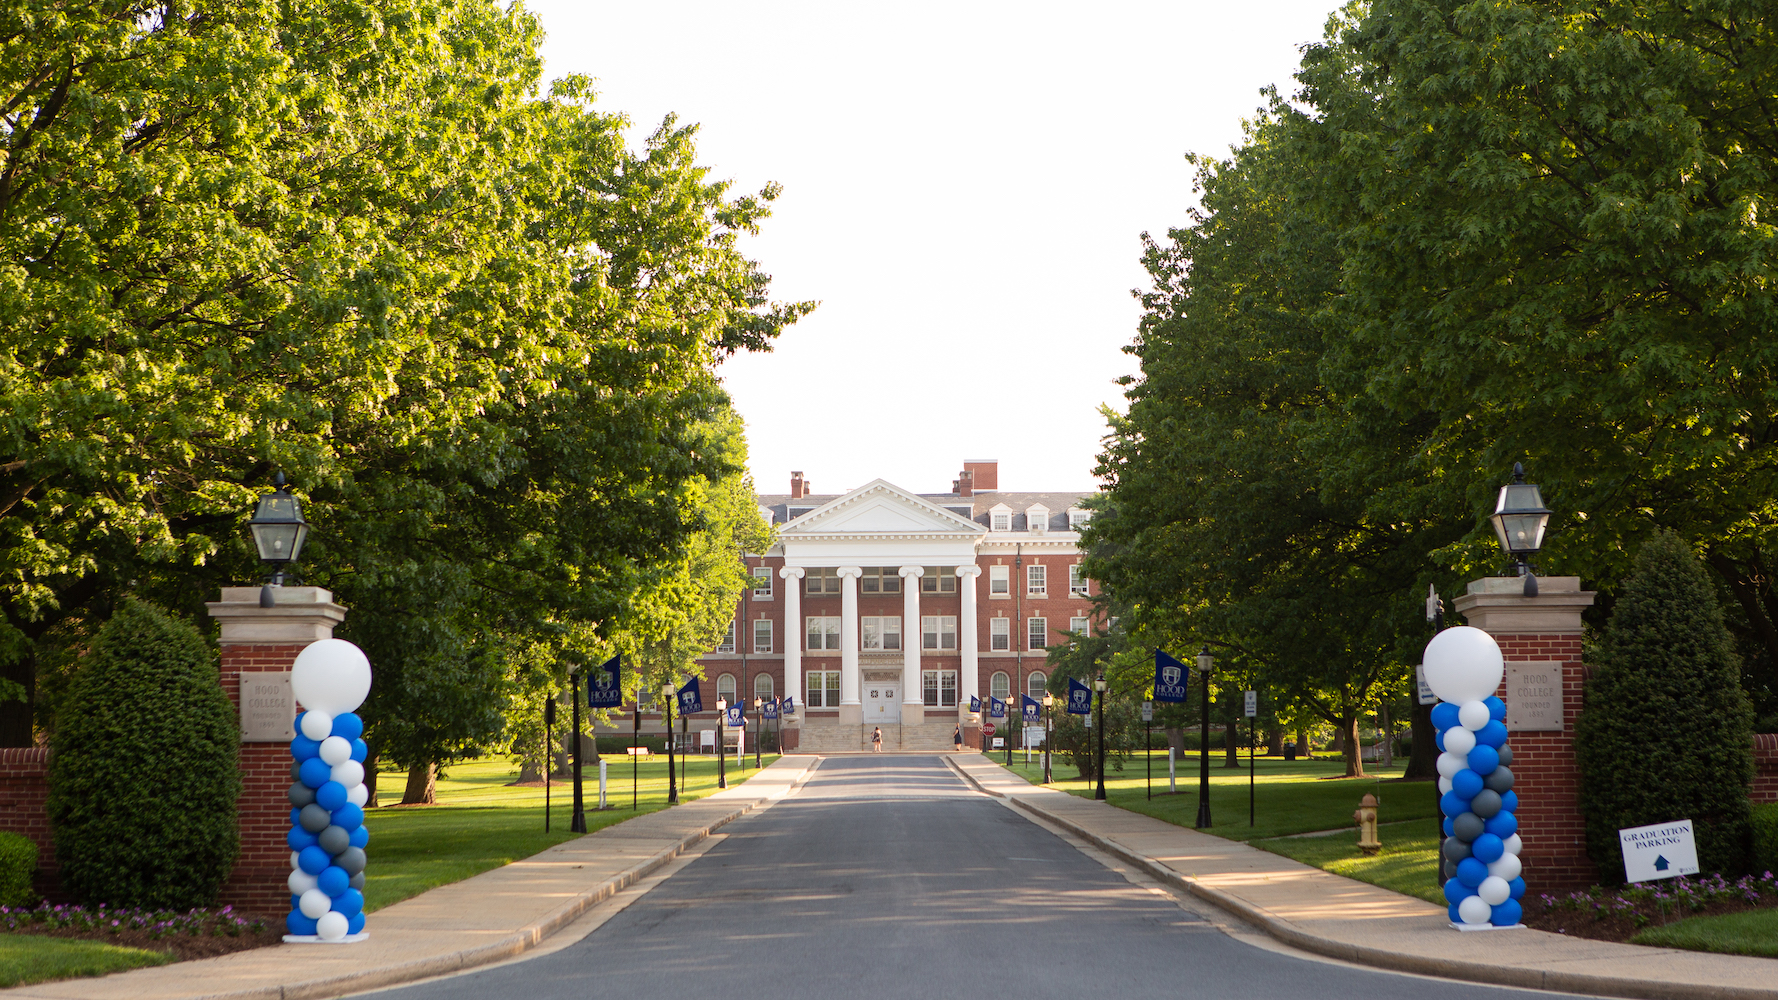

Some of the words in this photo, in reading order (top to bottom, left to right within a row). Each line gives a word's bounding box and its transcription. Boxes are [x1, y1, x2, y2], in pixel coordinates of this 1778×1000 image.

[1523, 674, 1548, 684] HOOD
[255, 685, 280, 695] HOOD
[590, 690, 619, 699] HOOD
[1157, 685, 1185, 694] HOOD
[1517, 687, 1554, 698] COLLEGE
[248, 698, 287, 709] COLLEGE
[1521, 701, 1551, 709] FOUNDED
[1623, 826, 1690, 842] GRADUATION
[1635, 836, 1681, 849] PARKING
